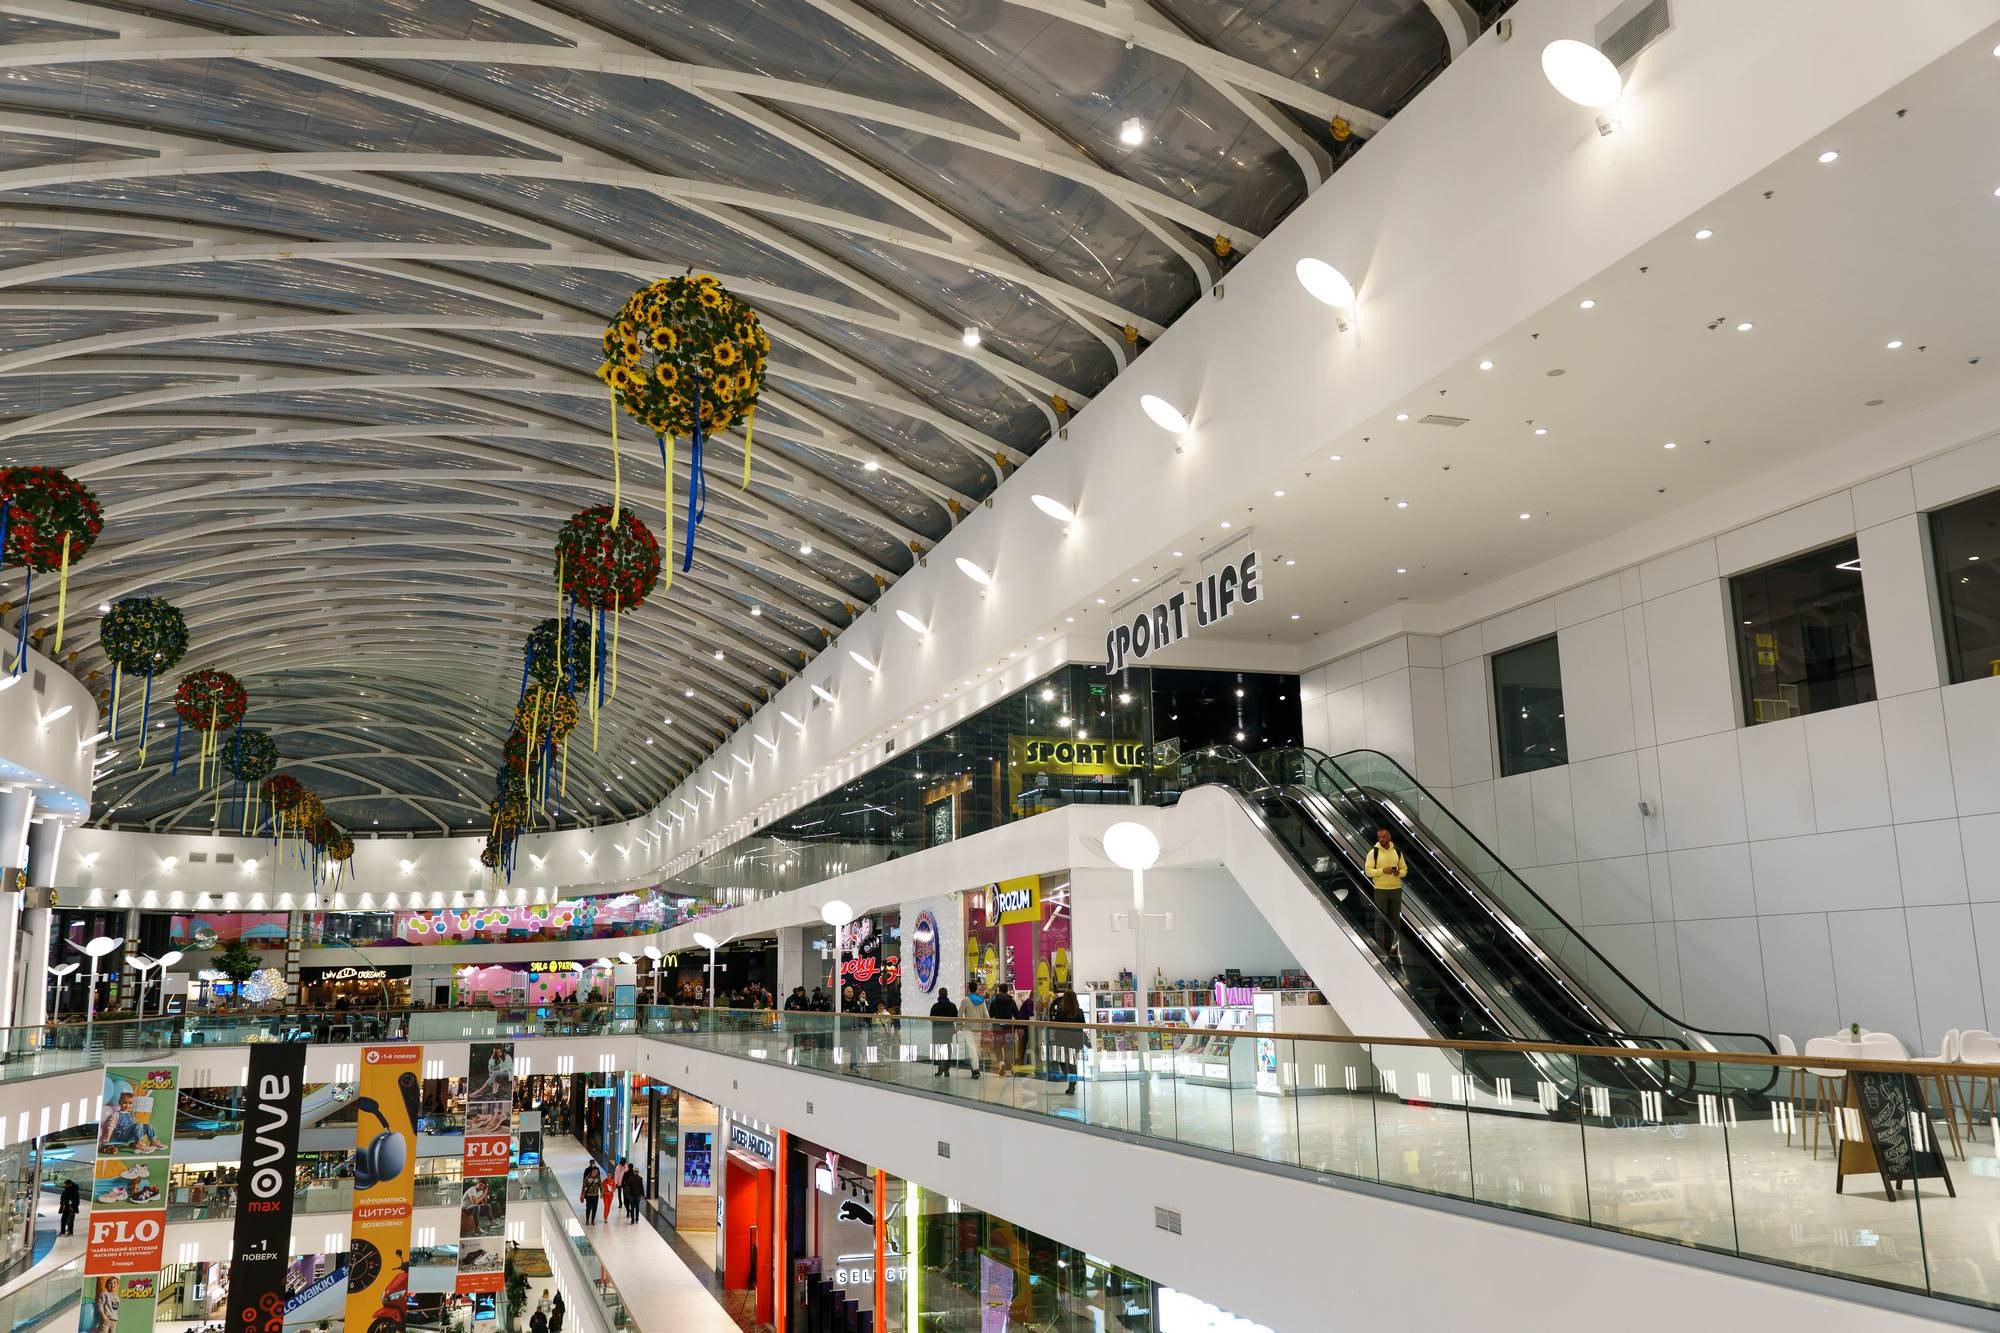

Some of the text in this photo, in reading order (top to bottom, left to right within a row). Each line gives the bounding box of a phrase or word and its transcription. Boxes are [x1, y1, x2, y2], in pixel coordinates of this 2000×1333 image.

[1105, 550, 1264, 675] SPORT LIFE
[1027, 741, 1164, 768] SPORT LIF
[1000, 889, 1031, 913] ROZUM
[322, 970, 336, 980] Lviv
[467, 1141, 508, 1157] FLO
[249, 1201, 281, 1213] max
[358, 1207, 406, 1218] ЦИТРУС
[91, 1219, 159, 1244] FLO
[242, 1252, 278, 1262] ПОВЕРХ
[838, 1268, 907, 1284] SELCT
[283, 1300, 296, 1314] LC
